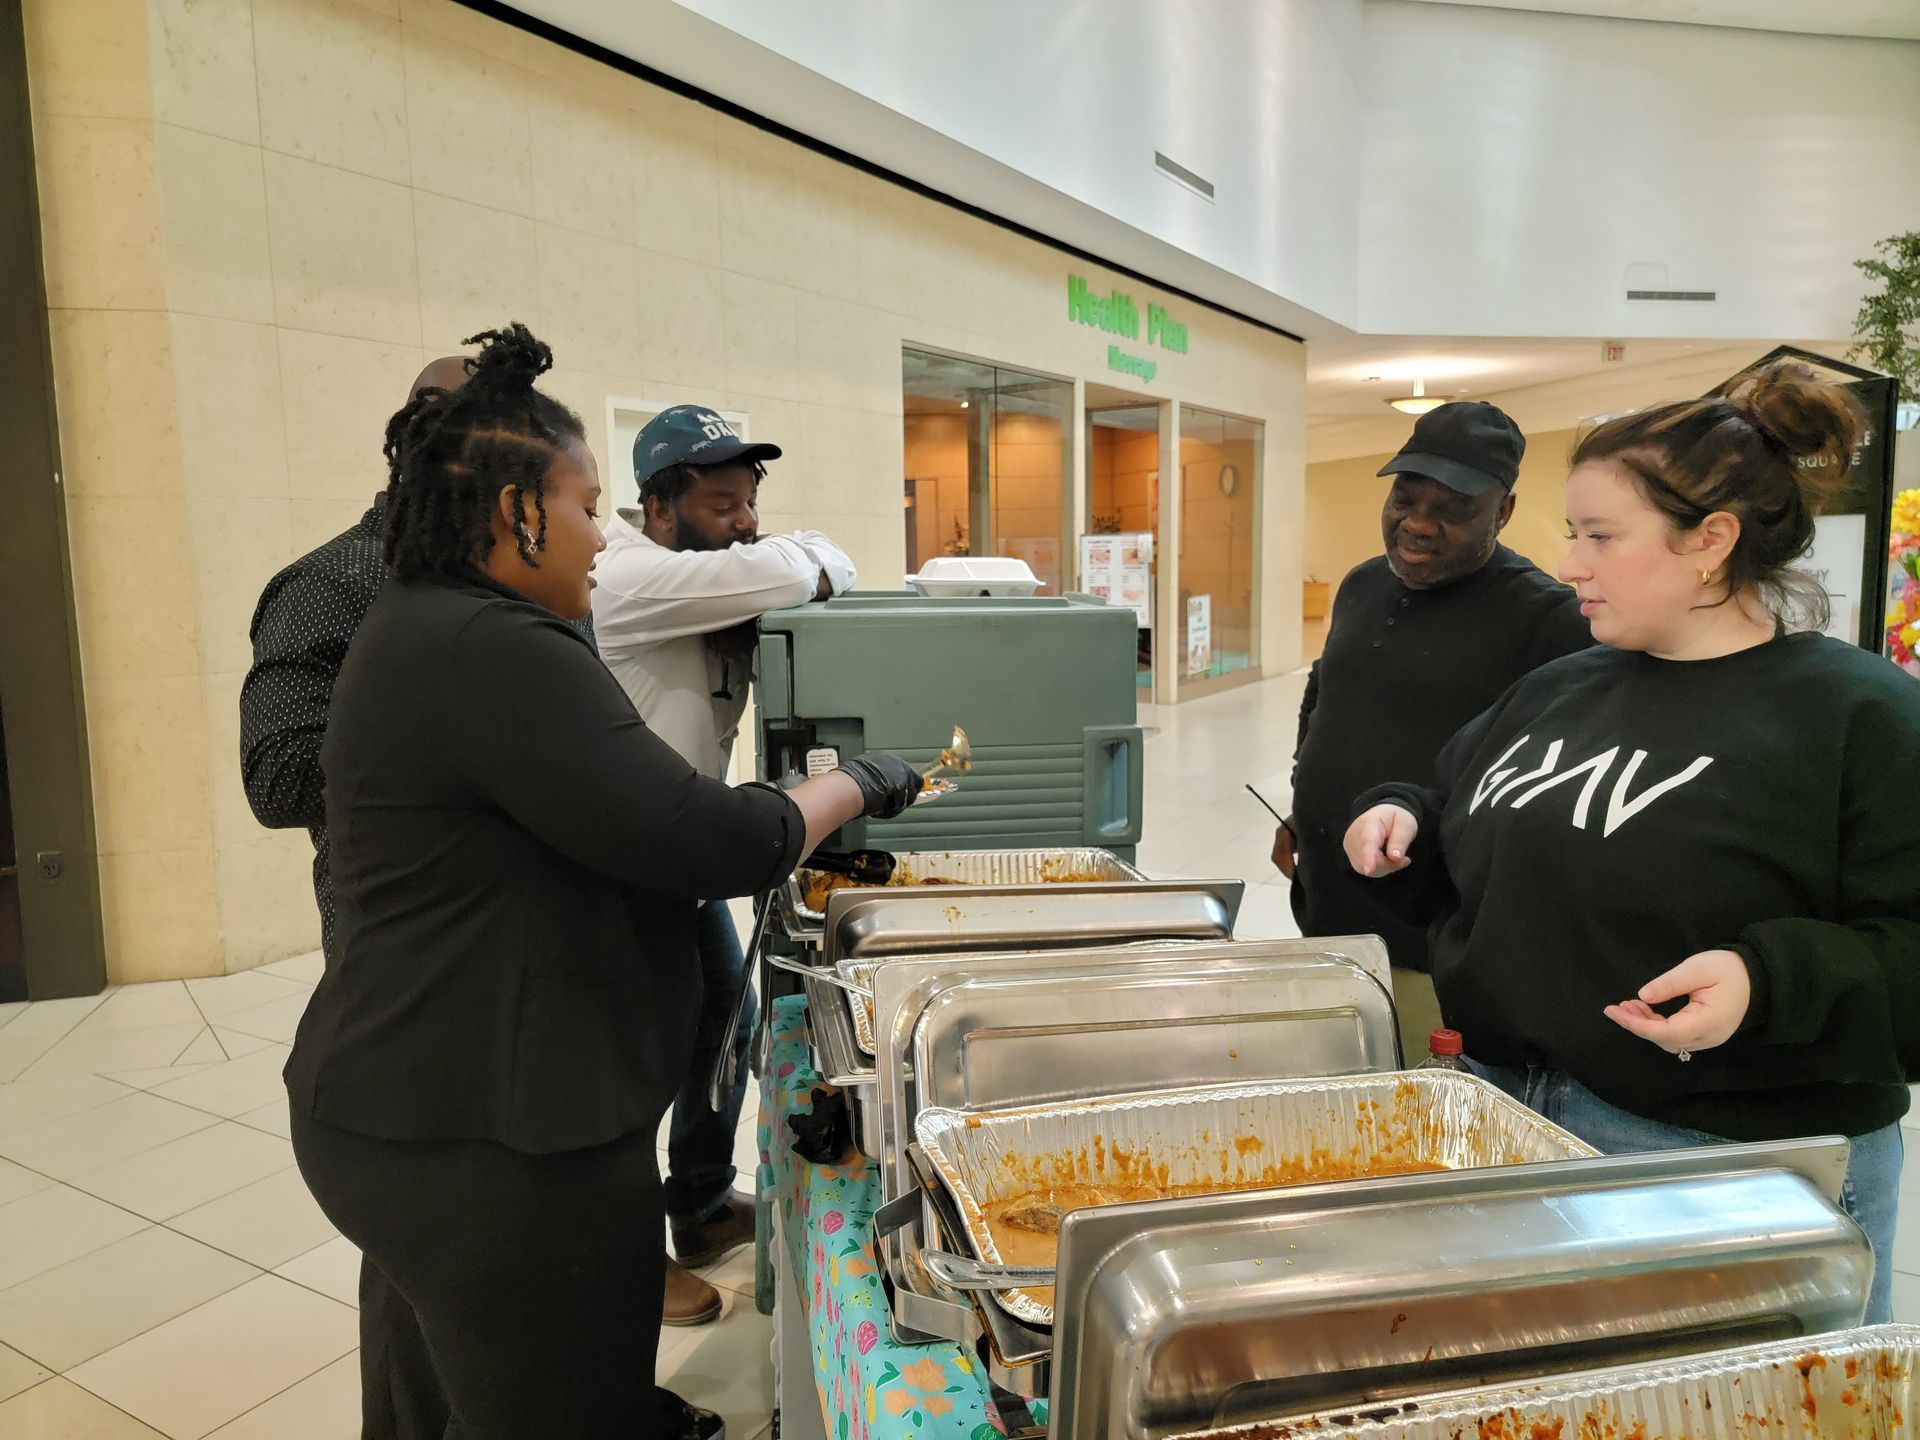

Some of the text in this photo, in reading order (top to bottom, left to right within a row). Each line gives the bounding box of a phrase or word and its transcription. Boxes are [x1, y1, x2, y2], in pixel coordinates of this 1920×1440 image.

[1068, 273, 1188, 354] Health Plan
[1796, 450, 1861, 469] SQUAE
